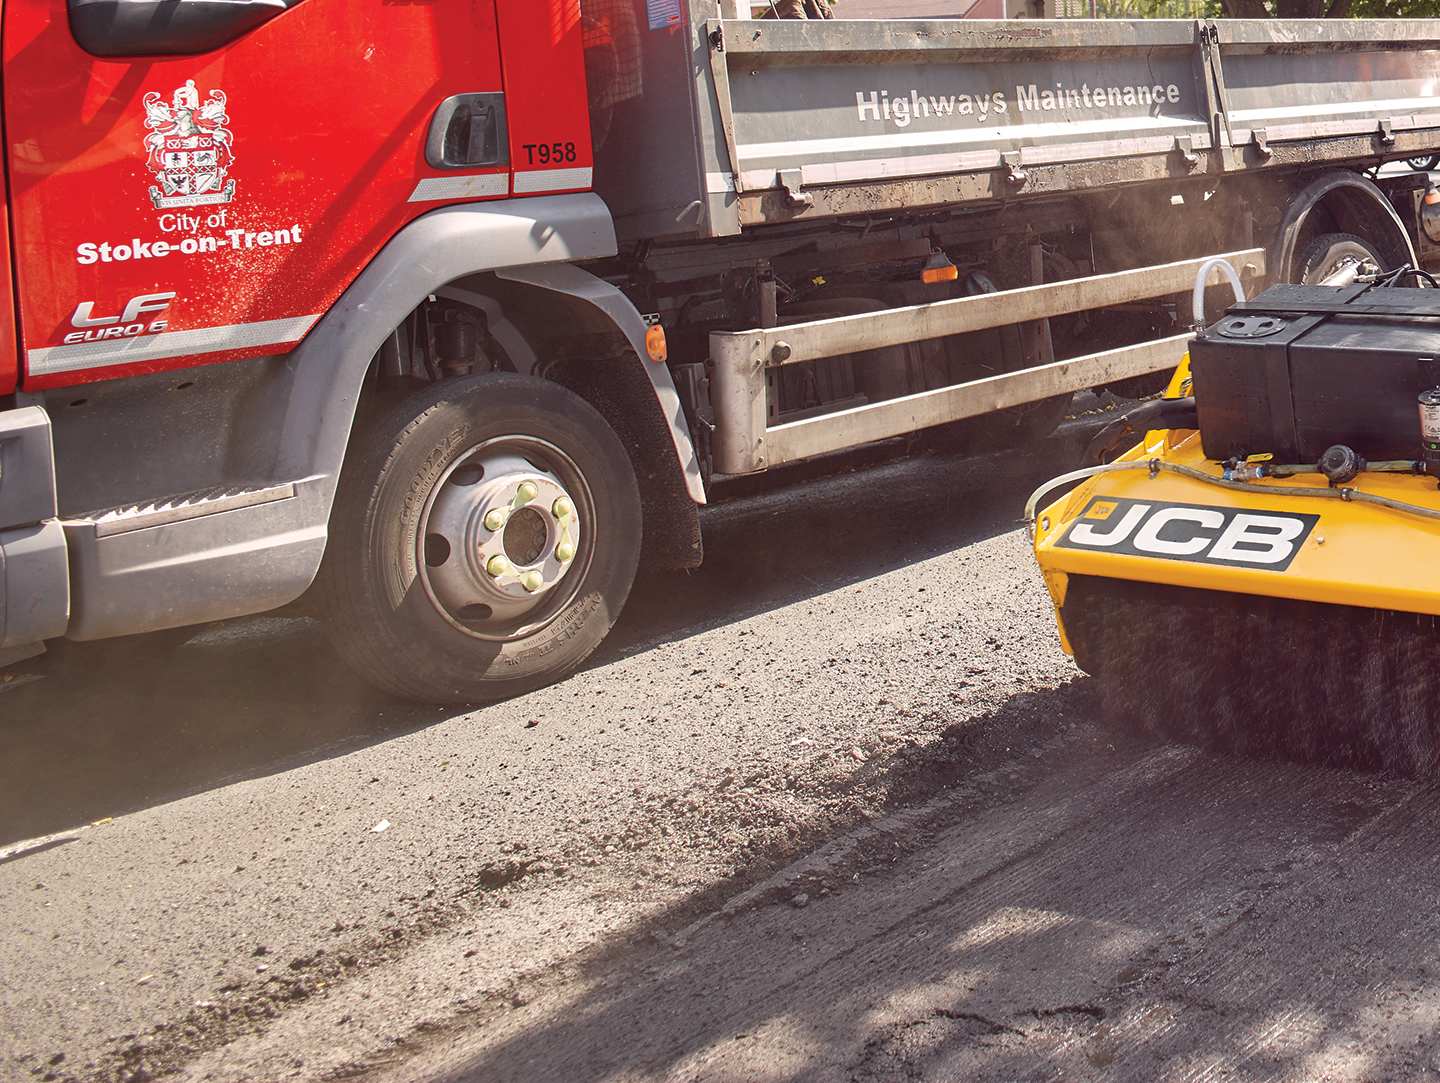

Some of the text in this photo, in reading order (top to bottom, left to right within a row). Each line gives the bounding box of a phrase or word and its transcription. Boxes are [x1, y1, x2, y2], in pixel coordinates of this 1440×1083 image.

[856, 82, 1181, 127] Highways Maintenance
[522, 142, 577, 165] T958
[172, 197, 194, 205] UNITA
[159, 210, 228, 234] City of
[76, 224, 303, 265] Stoke-on-Trent
[71, 291, 177, 328] LF
[63, 320, 169, 344] EURO 6
[401, 421, 470, 525] GOODYEA
[1069, 504, 1305, 564] JCB
